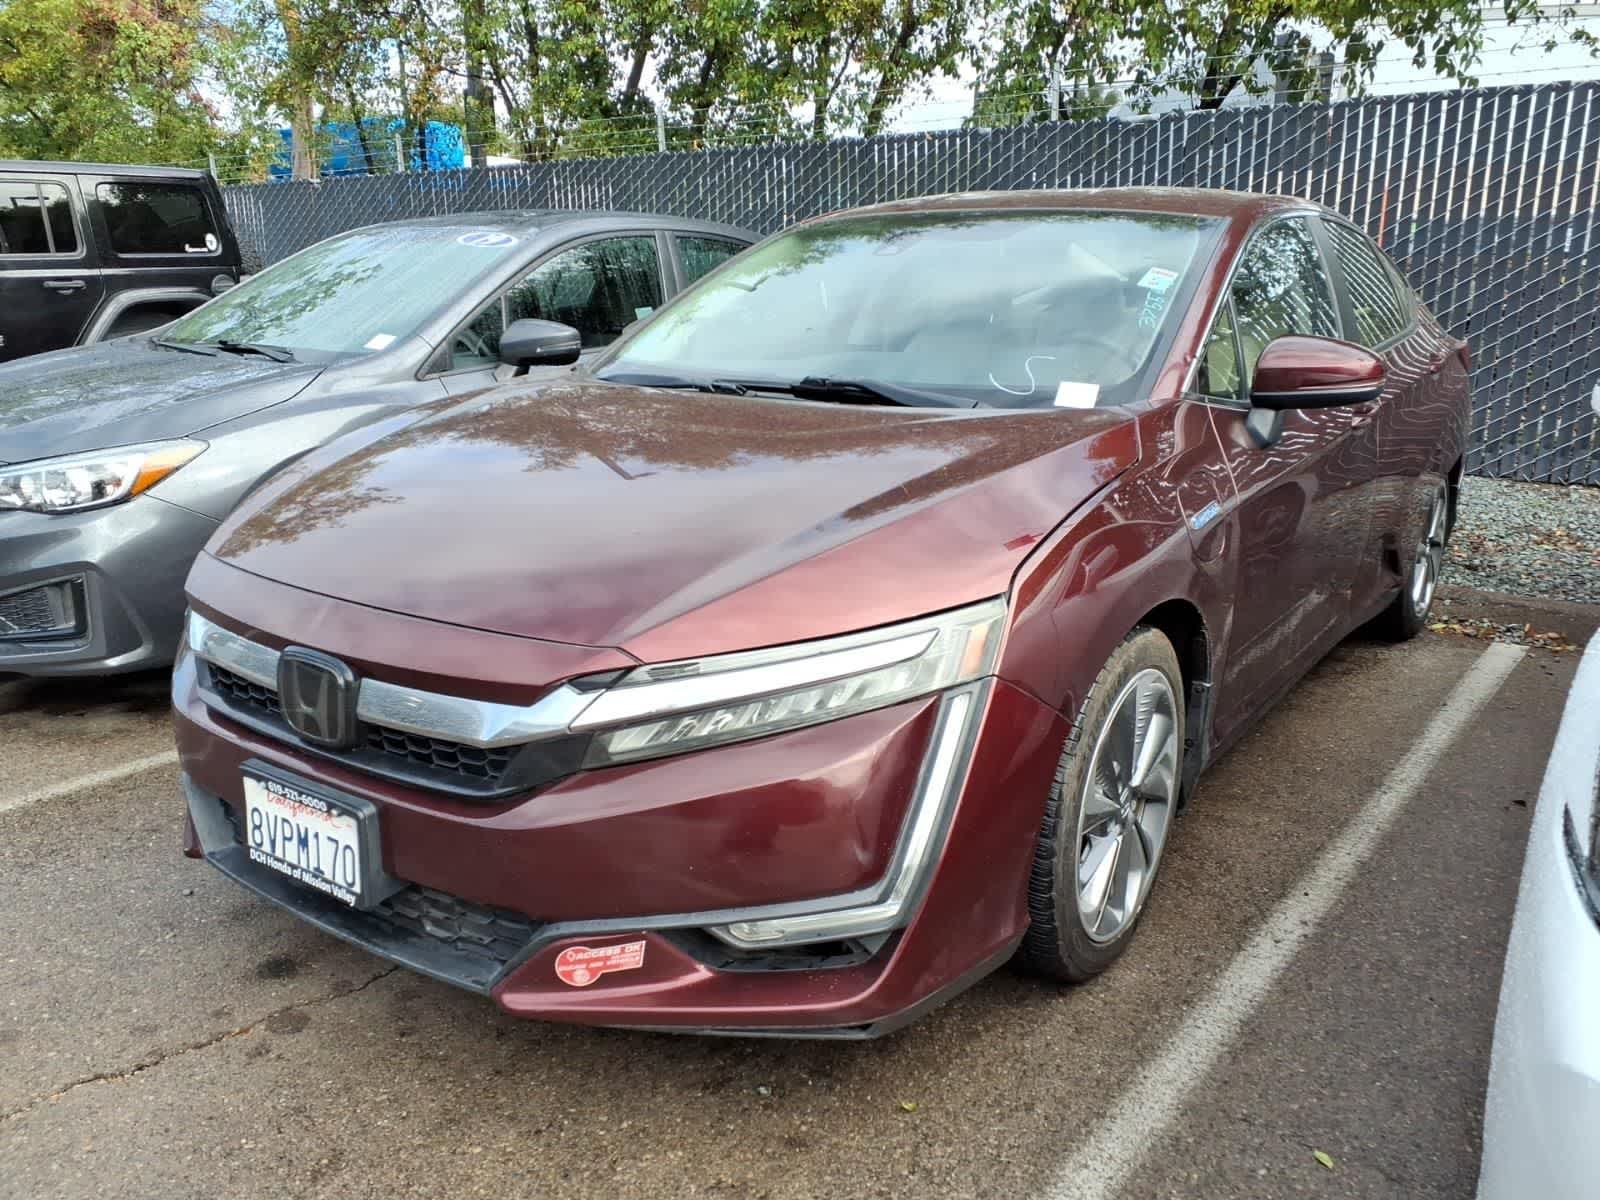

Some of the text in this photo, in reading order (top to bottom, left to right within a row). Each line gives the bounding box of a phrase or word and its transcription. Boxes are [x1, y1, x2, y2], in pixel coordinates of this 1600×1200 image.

[249, 847, 356, 907] DCH Honda of Mission Valley
[251, 807, 356, 889] 8VPM170
